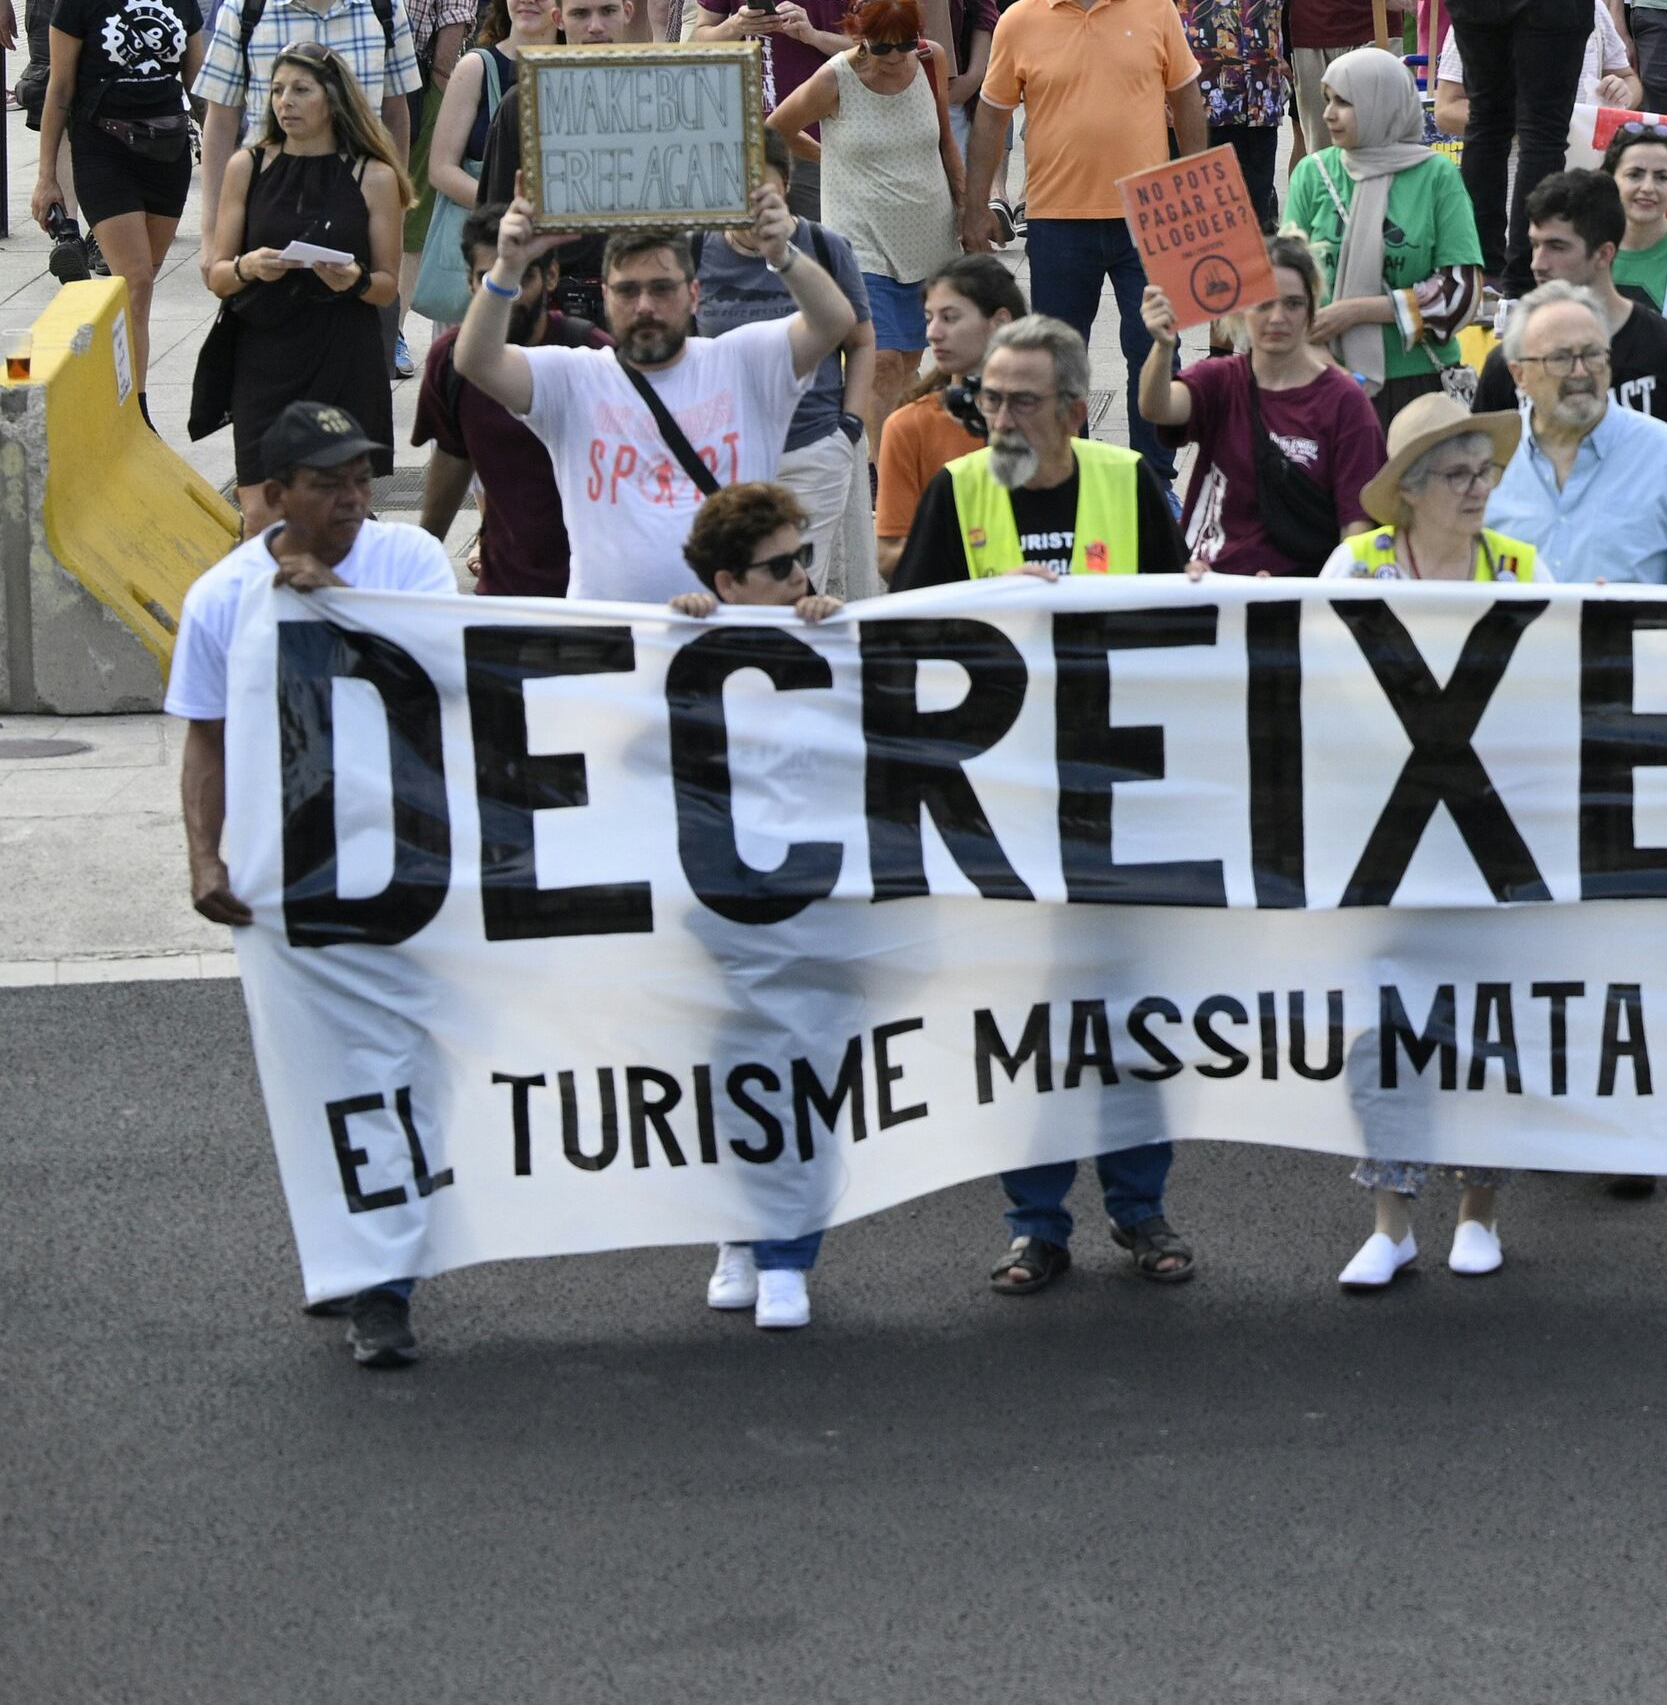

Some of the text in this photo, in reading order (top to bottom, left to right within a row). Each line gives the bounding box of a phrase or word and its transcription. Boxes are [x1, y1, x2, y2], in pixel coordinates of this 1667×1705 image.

[539, 65, 729, 136] MAKE BCN
[543, 140, 745, 214] FREE AGAIN
[1136, 161, 1227, 207] NO POTS
[1138, 183, 1241, 232] PAGAR EL
[1143, 206, 1249, 257] LLOGUER?
[325, 1086, 455, 1215] EL
[491, 1015, 930, 1176] TURISME
[972, 988, 1347, 1106] MASSIU
[1380, 980, 1654, 1097] MATA
